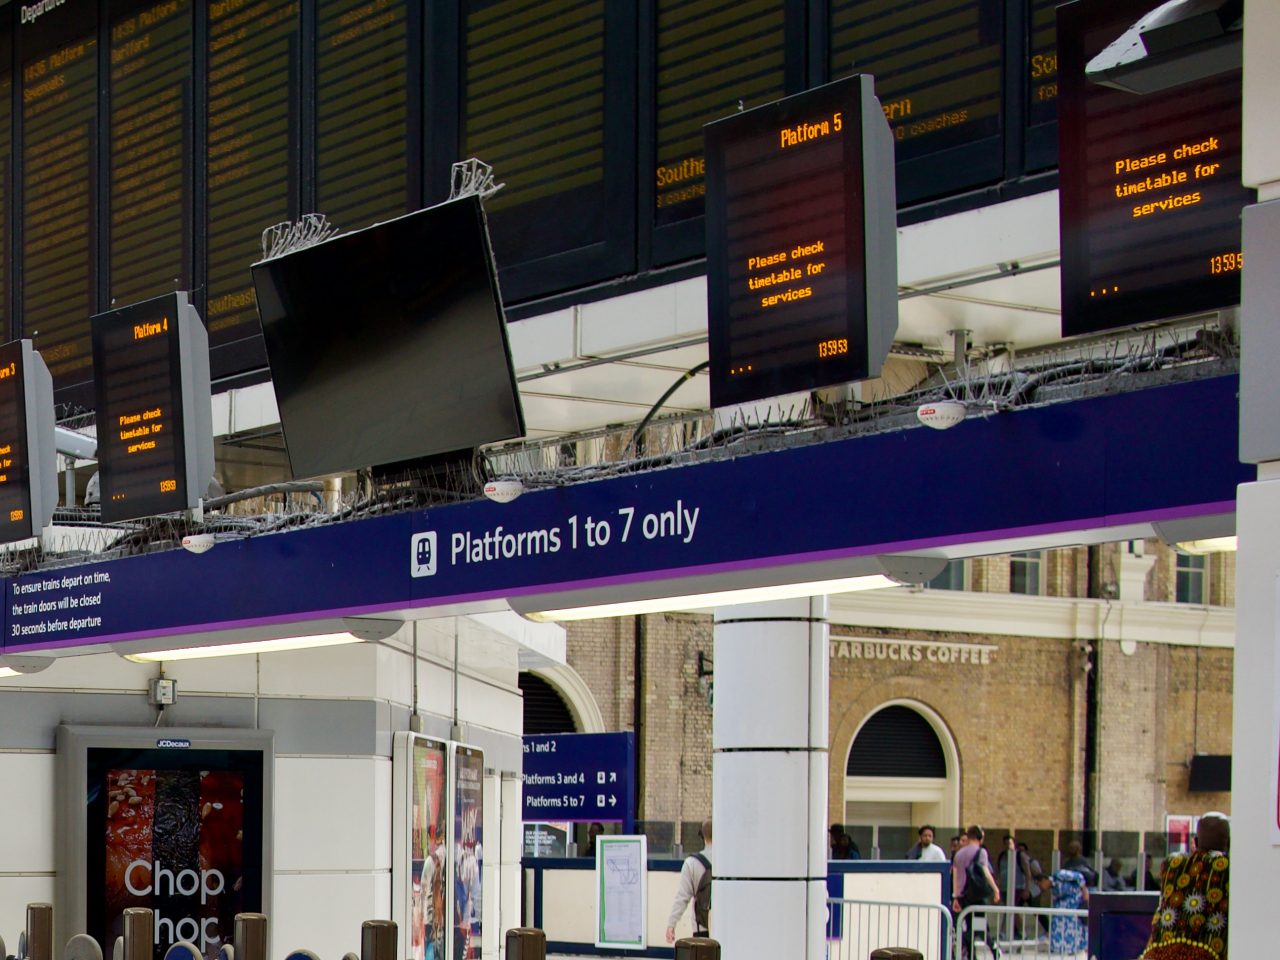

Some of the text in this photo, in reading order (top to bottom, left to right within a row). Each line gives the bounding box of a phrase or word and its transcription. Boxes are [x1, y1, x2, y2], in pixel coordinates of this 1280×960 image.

[780, 112, 842, 148] Platform 5
[1115, 137, 1218, 174] Please check
[656, 158, 705, 186] Southe
[1115, 163, 1220, 197] timetable for
[666, 184, 705, 205] coache
[1133, 192, 1201, 217] services
[748, 241, 824, 270] Please check
[1210, 252, 1243, 274] 13595
[748, 263, 825, 290] timetable for
[761, 287, 812, 307] services
[134, 317, 168, 340] Platform 4
[10, 362, 15, 376] 3
[120, 408, 161, 426] Please check
[120, 423, 162, 440] timetable for
[128, 441, 156, 453] services
[3, 459, 12, 468] for
[451, 500, 700, 566] Platforms 1 to 7 only
[12, 583, 20, 595] To
[21, 581, 41, 594] ensure
[42, 578, 60, 591] trains
[61, 576, 83, 590] depart
[83, 574, 93, 586] on
[12, 593, 101, 616] the train doors will be closed
[11, 615, 102, 637] 30 seconds before departure
[830, 640, 990, 666] TARBUCKS COFFEE
[157, 739, 190, 748] JCDecaux
[535, 741, 550, 753] and
[551, 741, 557, 752] 2
[522, 772, 585, 785] Platforms 3 and 4
[526, 795, 585, 807] Platforms 5 to 7
[124, 859, 225, 905] Chop
[154, 909, 220, 954] hop
